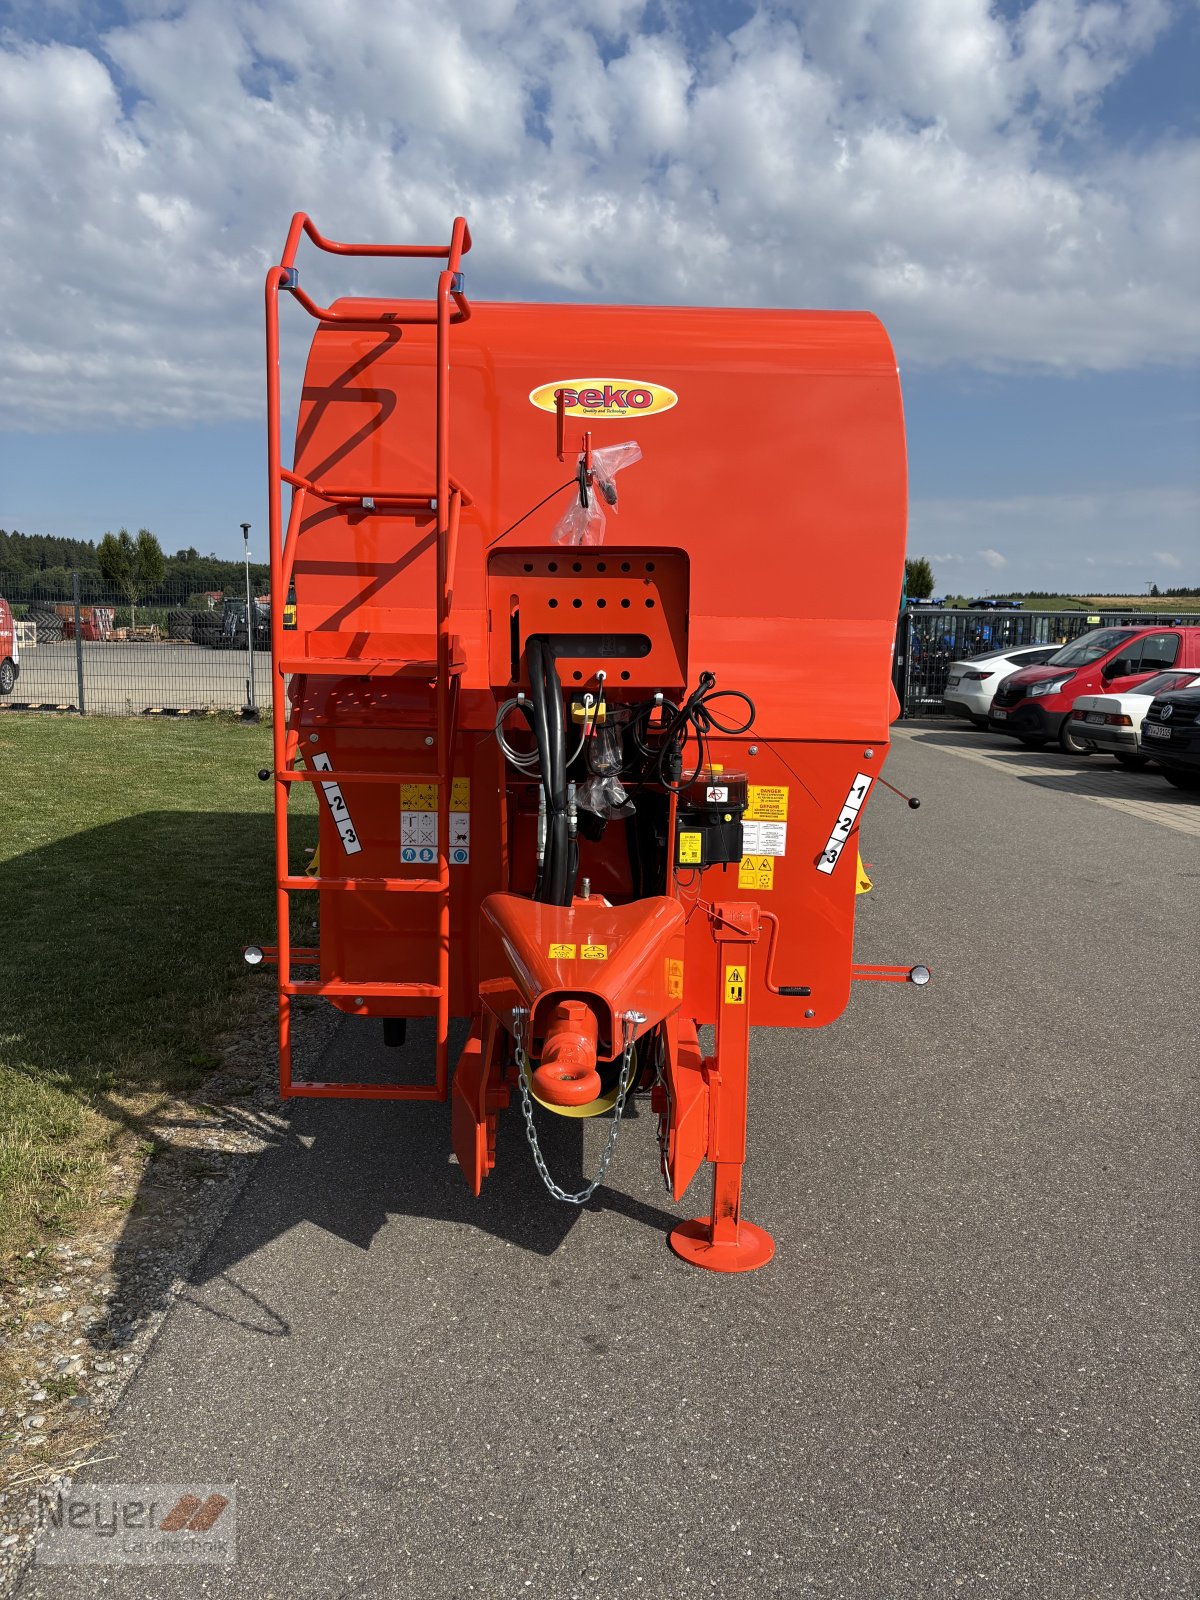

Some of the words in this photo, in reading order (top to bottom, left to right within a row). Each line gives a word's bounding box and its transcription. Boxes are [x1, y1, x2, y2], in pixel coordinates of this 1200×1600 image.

[553, 385, 653, 408] seko
[857, 785, 866, 800] 1
[333, 796, 345, 811] 2
[345, 829, 356, 843] 3
[839, 817, 852, 832] 2
[826, 849, 838, 864] 3
